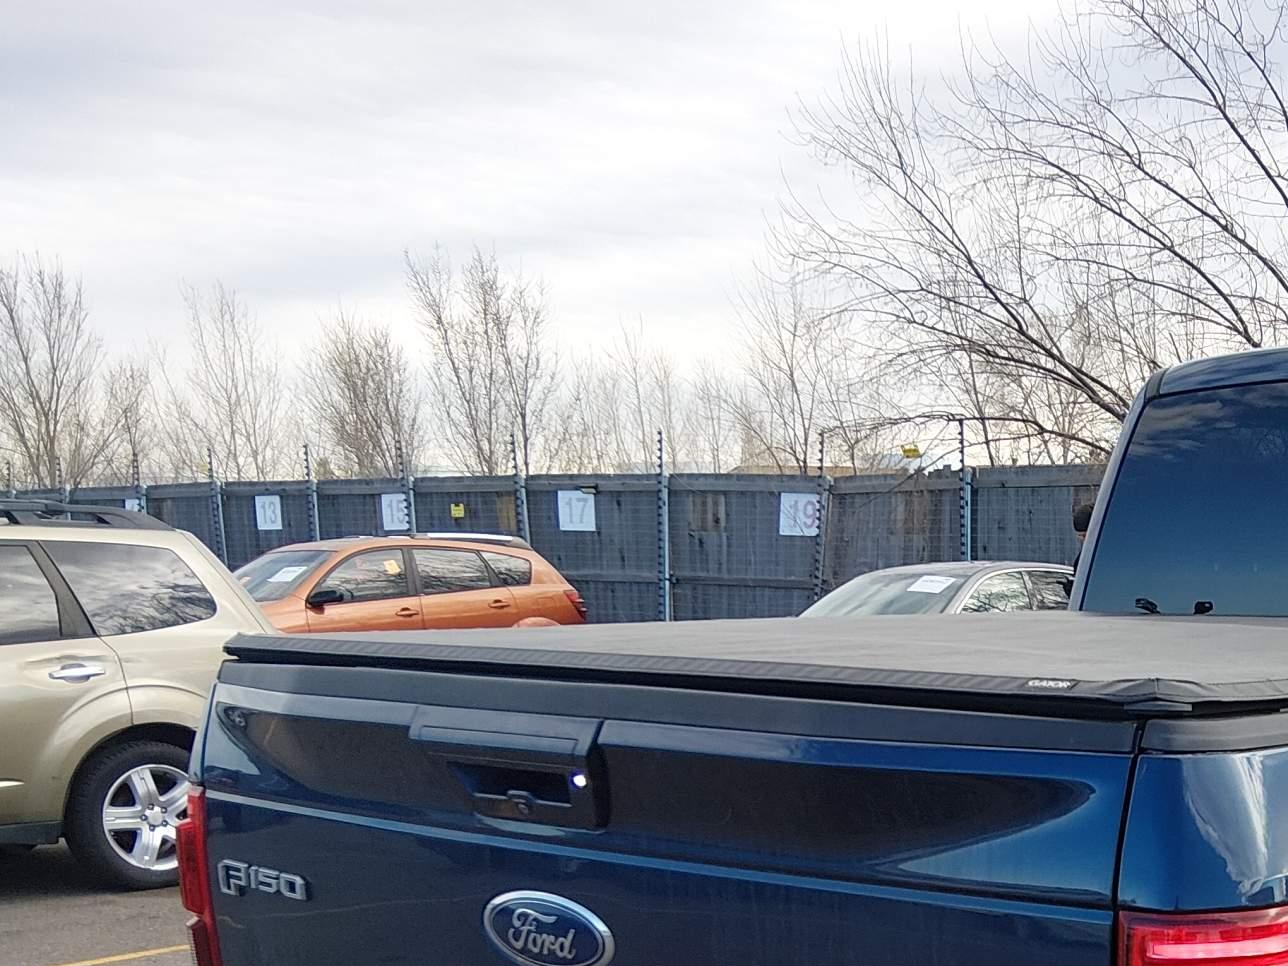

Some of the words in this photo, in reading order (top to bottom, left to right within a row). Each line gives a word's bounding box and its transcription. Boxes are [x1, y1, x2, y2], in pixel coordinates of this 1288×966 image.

[260, 501, 278, 525] 13
[563, 496, 589, 525] 17
[788, 499, 818, 530] 19
[507, 907, 577, 960] Ford
